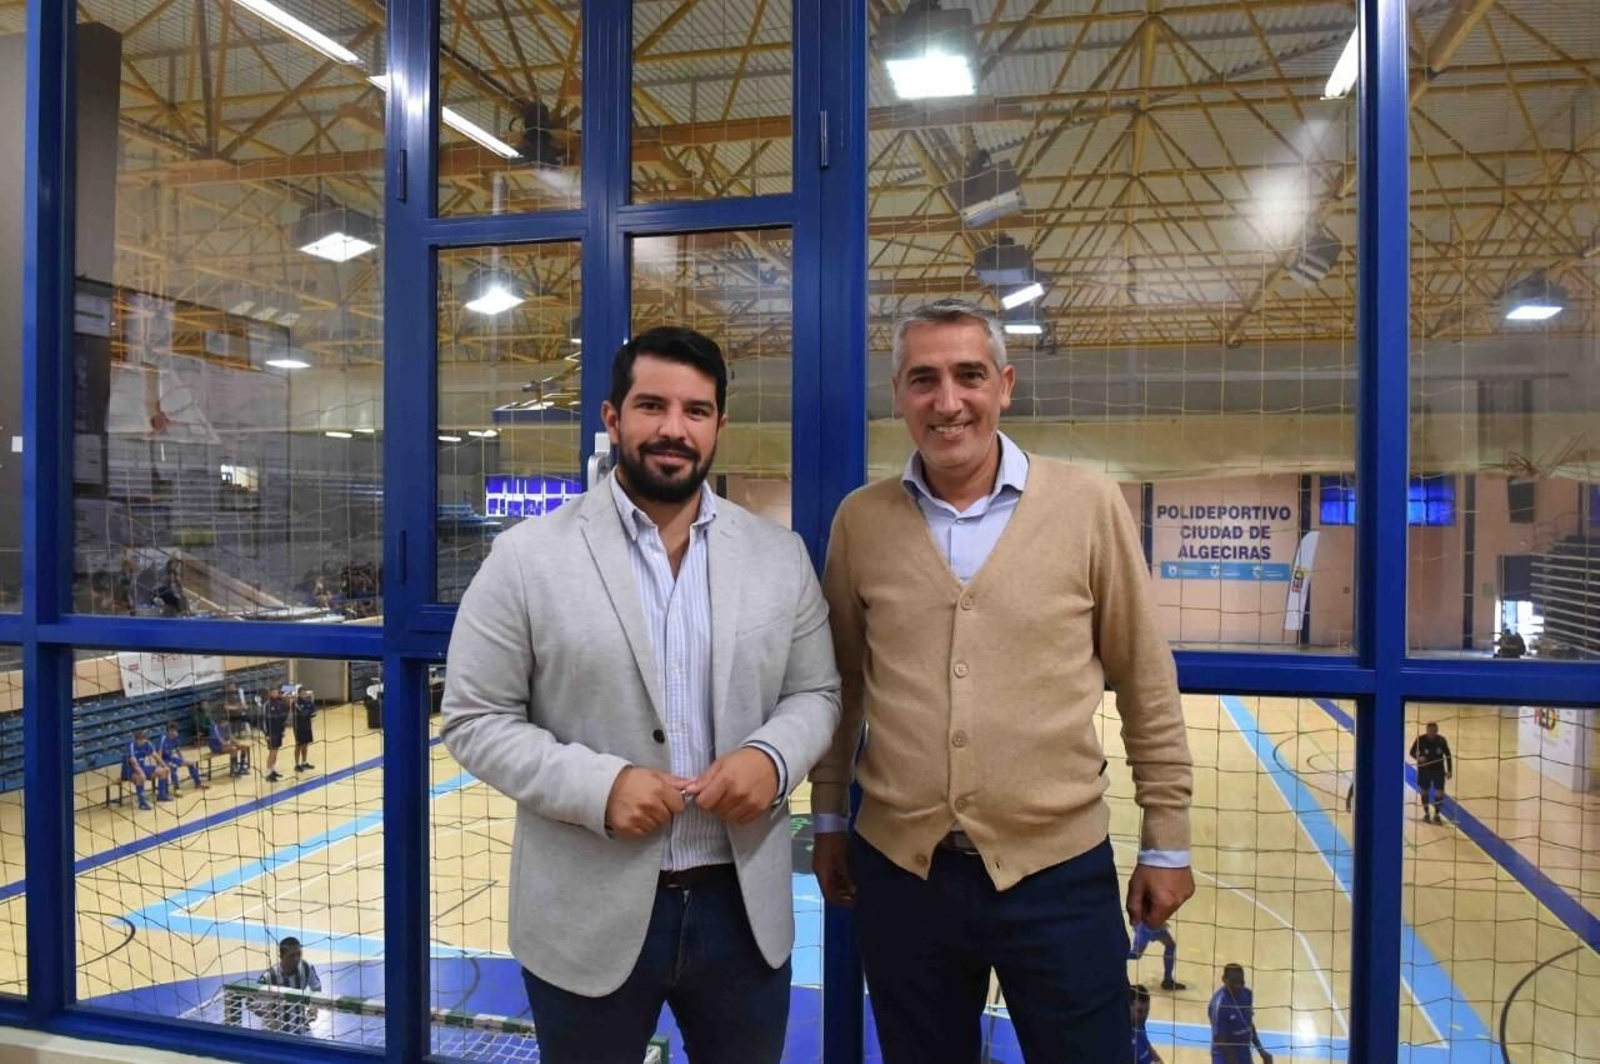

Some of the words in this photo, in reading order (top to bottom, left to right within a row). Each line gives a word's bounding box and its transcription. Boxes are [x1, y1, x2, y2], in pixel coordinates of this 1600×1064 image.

[1157, 505, 1291, 520] POLIDEPORTIVO
[1180, 525, 1243, 539] CIUDAD
[1249, 526, 1271, 539] DE
[1178, 545, 1271, 560] ALGECIRAS
